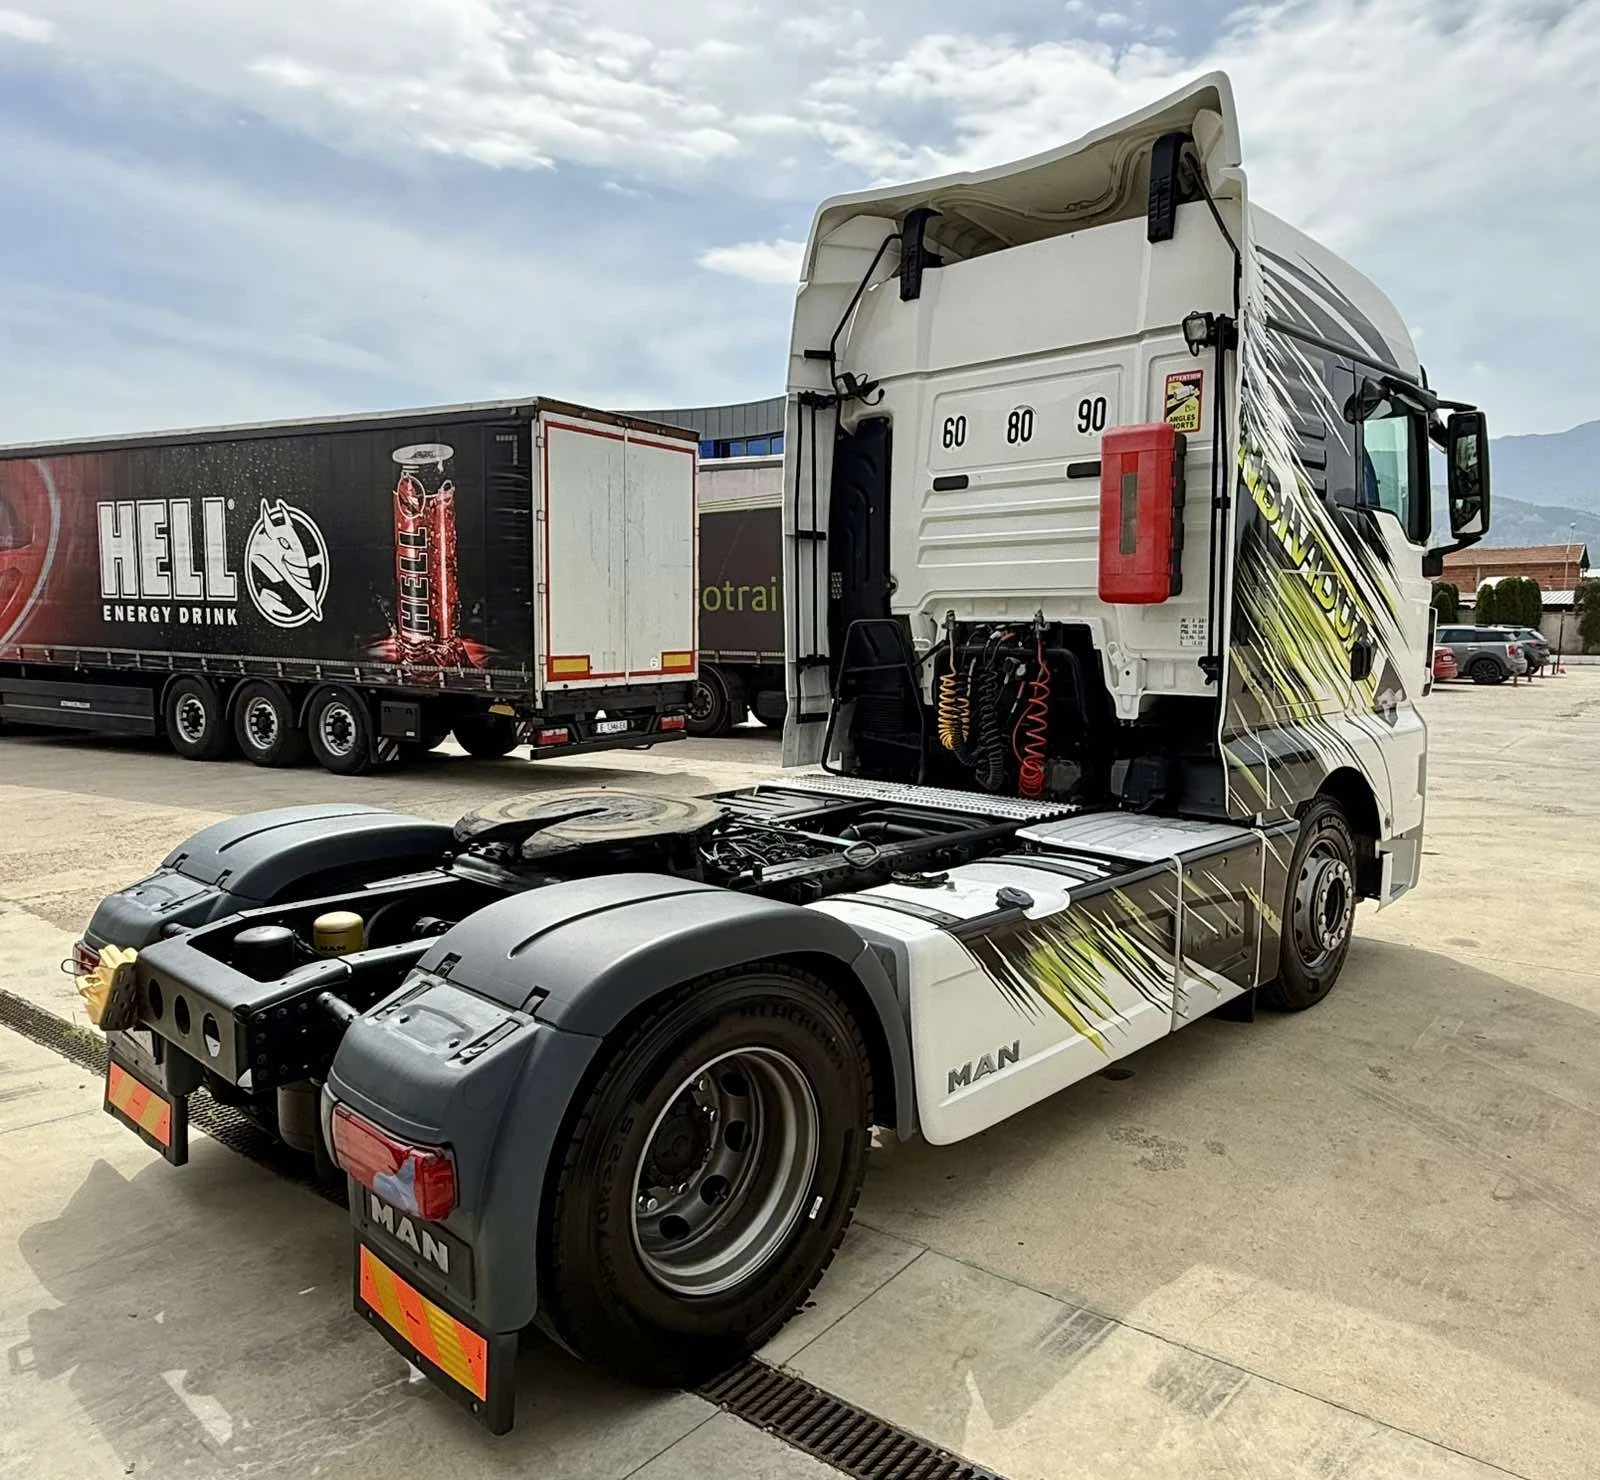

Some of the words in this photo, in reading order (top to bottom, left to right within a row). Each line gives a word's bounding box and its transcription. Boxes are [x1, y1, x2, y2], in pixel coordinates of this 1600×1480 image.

[943, 415, 967, 449] 60
[1007, 408, 1034, 444] 80
[1077, 396, 1107, 433] 90
[1170, 414, 1195, 422] ANGLES
[97, 497, 238, 601] HELL
[398, 526, 430, 632] HELL
[702, 576, 777, 612] otrai
[103, 604, 171, 623] ENERGY
[179, 607, 239, 626] DRINK
[947, 1039, 1021, 1095] MAN
[370, 1193, 450, 1275] MAN
